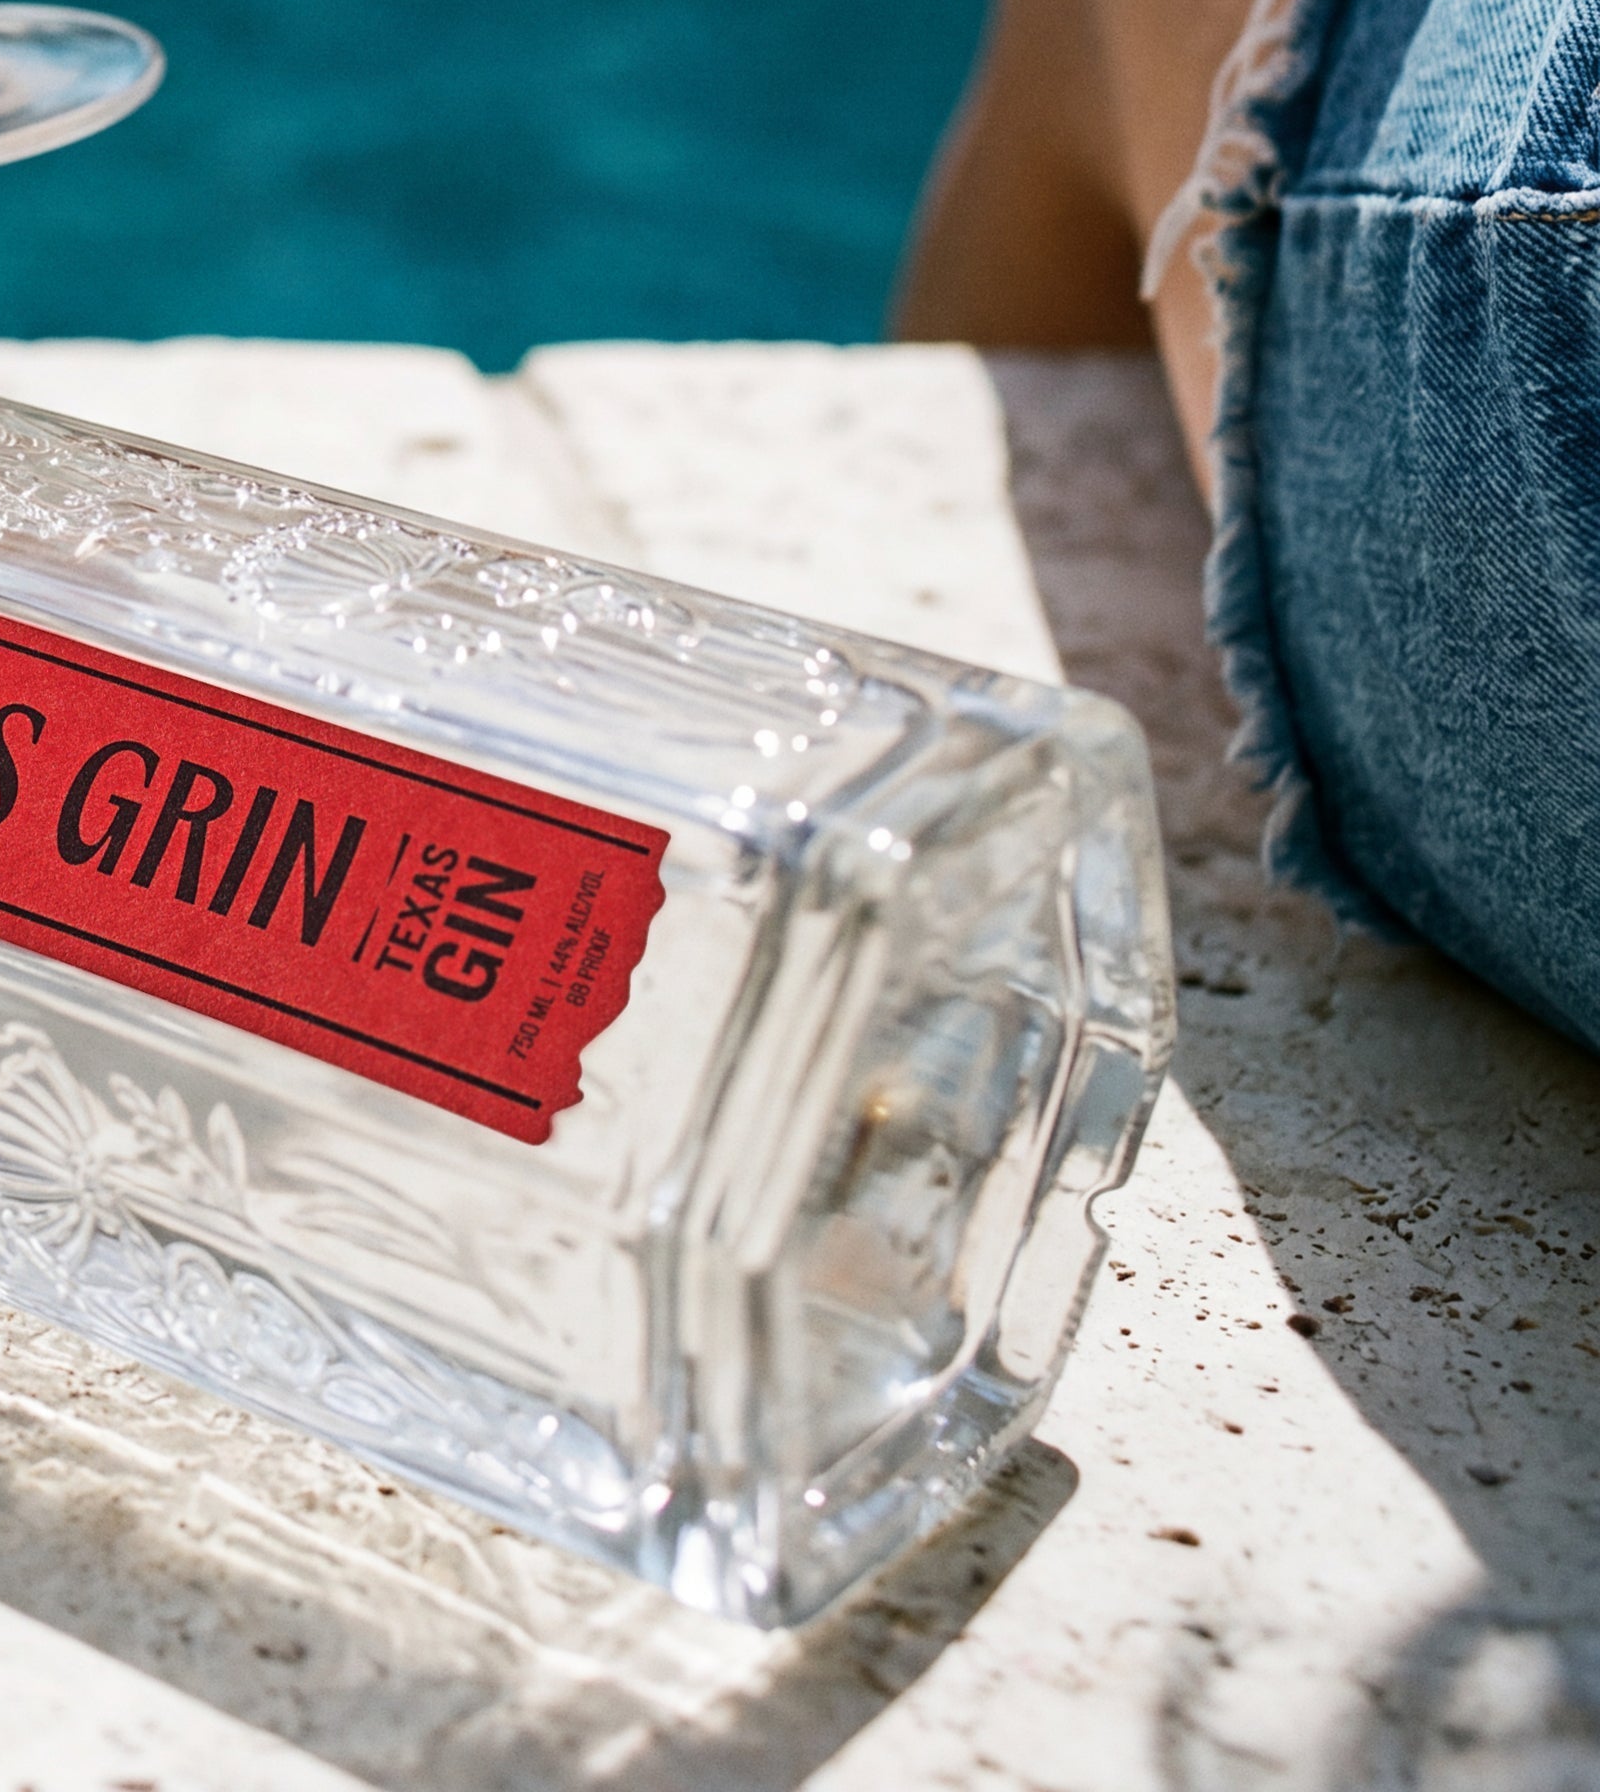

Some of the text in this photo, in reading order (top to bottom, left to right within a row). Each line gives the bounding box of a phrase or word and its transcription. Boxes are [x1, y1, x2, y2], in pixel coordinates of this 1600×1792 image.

[57, 740, 368, 948] GRIN
[373, 842, 460, 974] TEXAS
[421, 855, 538, 1004] GIN
[507, 869, 606, 1061] 750 ML 44% ALC/VOL
[565, 927, 613, 1008] 88 PROOF
